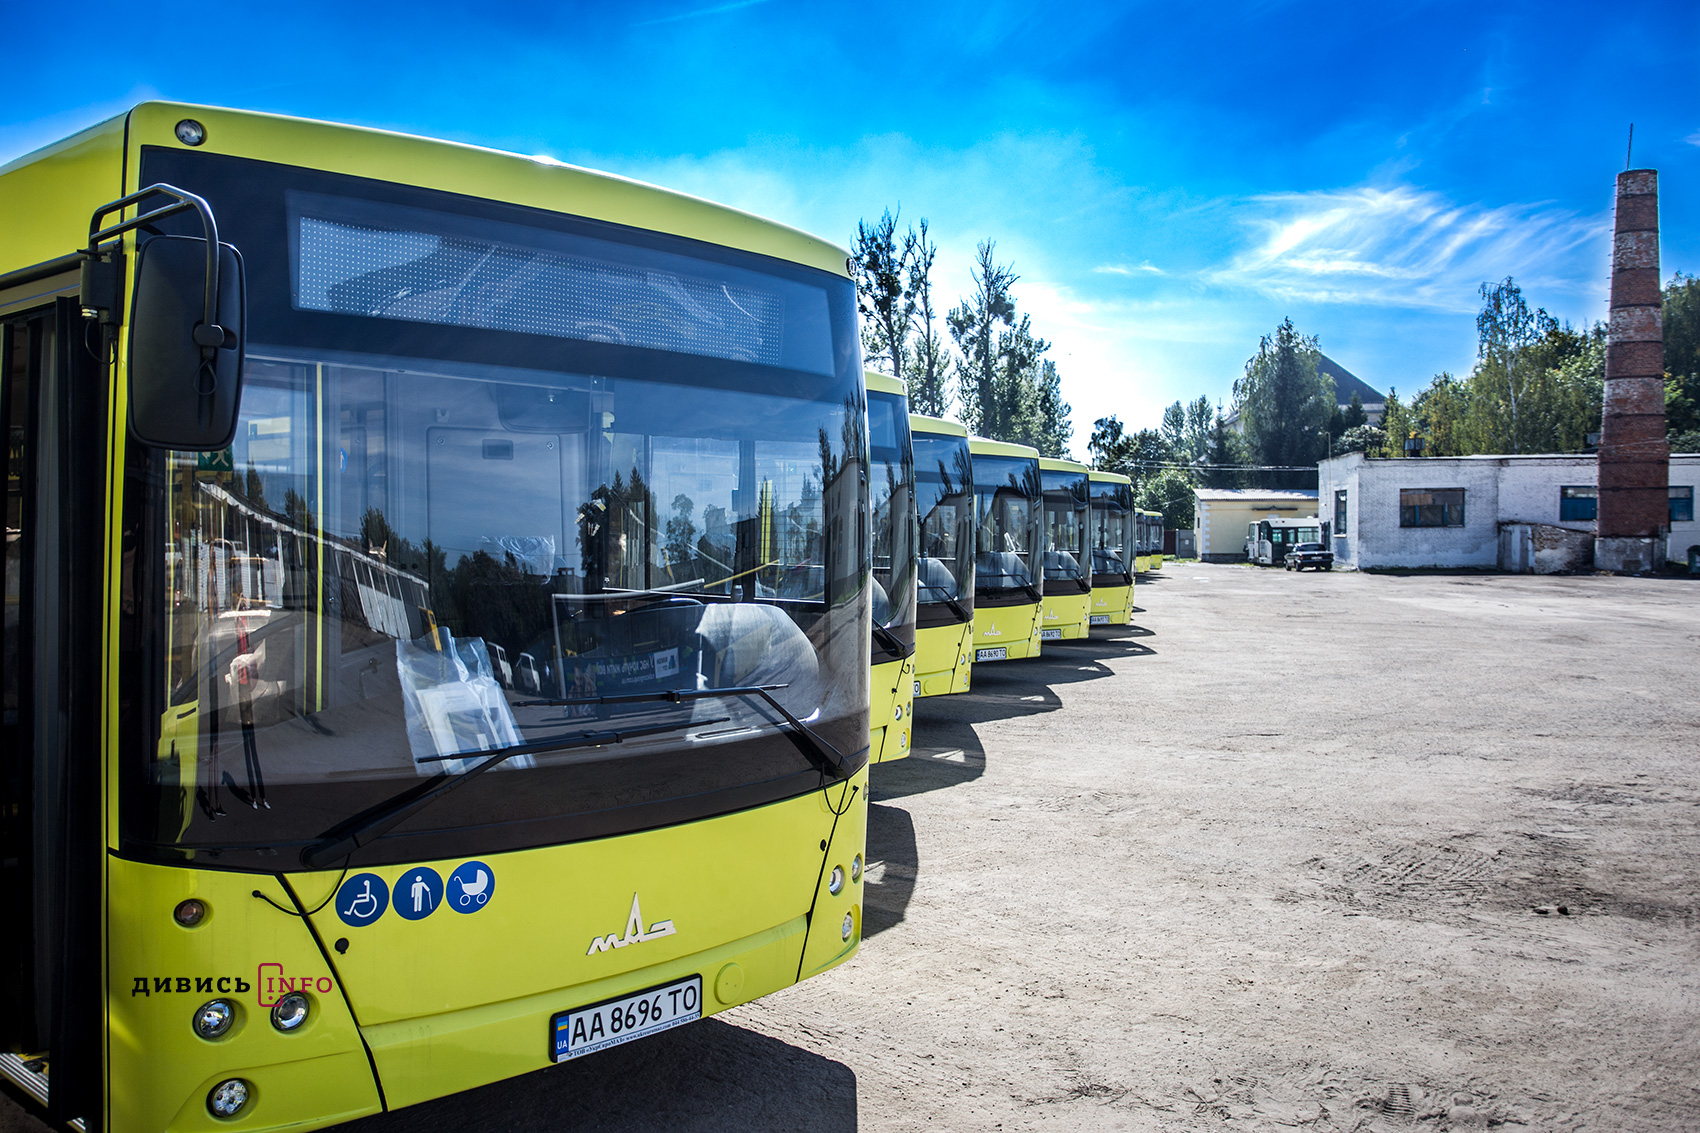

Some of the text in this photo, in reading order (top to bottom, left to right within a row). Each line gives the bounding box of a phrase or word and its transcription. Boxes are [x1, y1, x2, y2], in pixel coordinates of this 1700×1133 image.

[999, 649, 1006, 657] TO
[571, 985, 697, 1046] AA 8696 TO
[557, 1040, 568, 1050] UA
